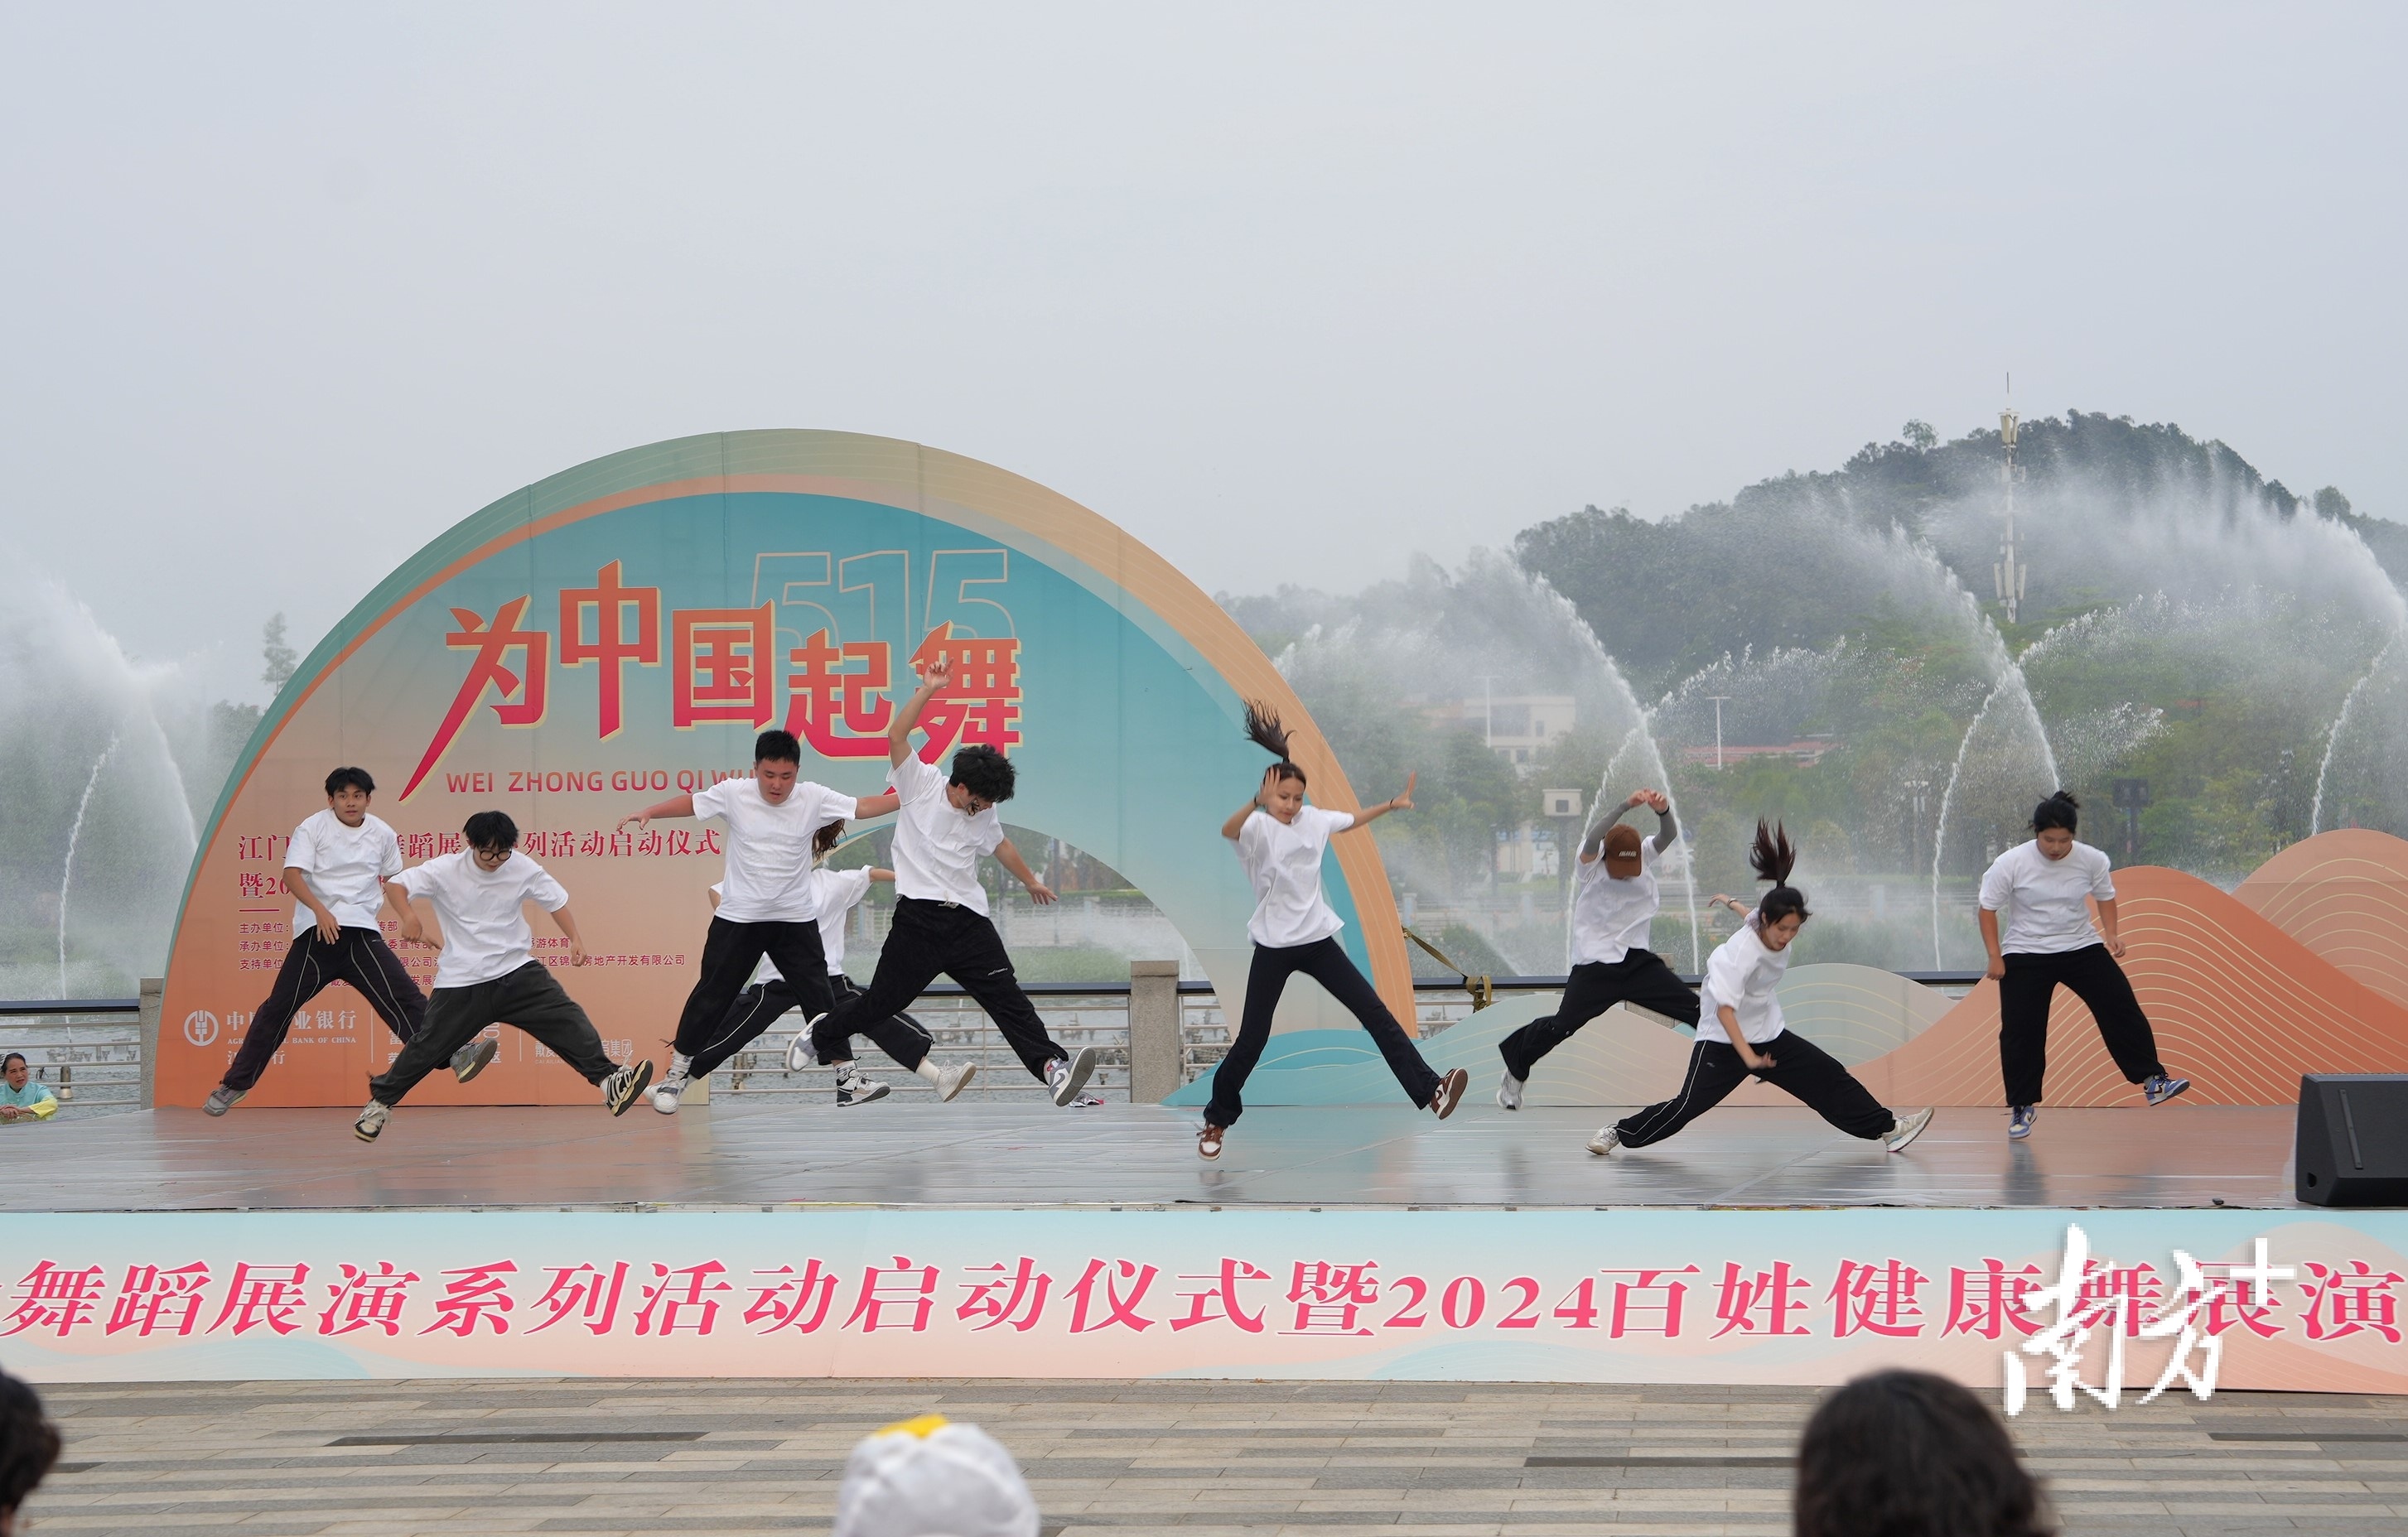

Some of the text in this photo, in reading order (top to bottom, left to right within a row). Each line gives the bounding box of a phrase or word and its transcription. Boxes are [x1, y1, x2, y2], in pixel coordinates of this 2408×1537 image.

[398, 558, 1022, 802] 为中国起舞
[750, 549, 1016, 686] 515
[446, 772, 494, 793] WEI
[508, 771, 603, 793] ZHONG
[611, 769, 668, 792] GUO
[677, 769, 703, 794] QI
